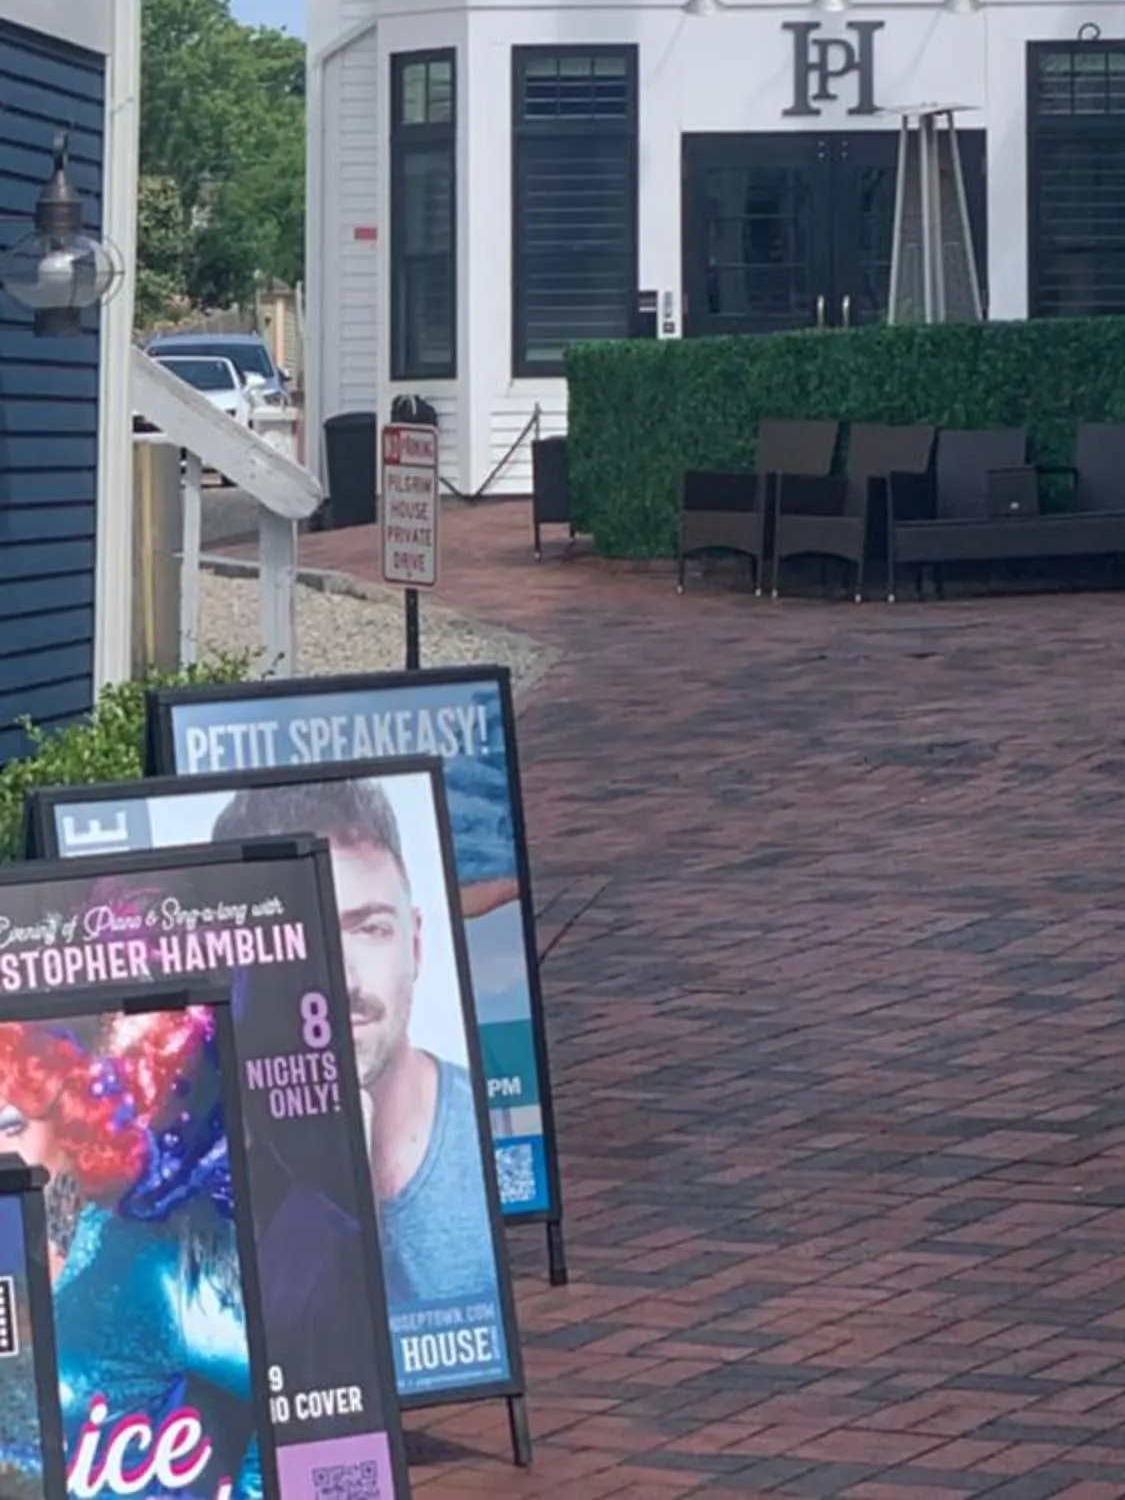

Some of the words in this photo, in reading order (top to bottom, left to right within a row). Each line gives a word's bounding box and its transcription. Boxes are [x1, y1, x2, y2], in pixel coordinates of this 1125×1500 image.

[387, 473, 432, 493] PILGRIM
[391, 502, 428, 520] HOUSE
[387, 525, 432, 546] PRIVATE
[393, 552, 425, 572] DRIVE
[185, 720, 278, 774] PETIT
[288, 704, 488, 766] SPEAKEASY!
[159, 922, 307, 975] HAMBLIN
[300, 991, 332, 1049] 8
[246, 1050, 338, 1090] NIGHTS
[487, 1076, 522, 1098] PM
[269, 1083, 342, 1119] ONLY!
[400, 1326, 493, 1373] HOUSE
[294, 1386, 364, 1420] COVER
